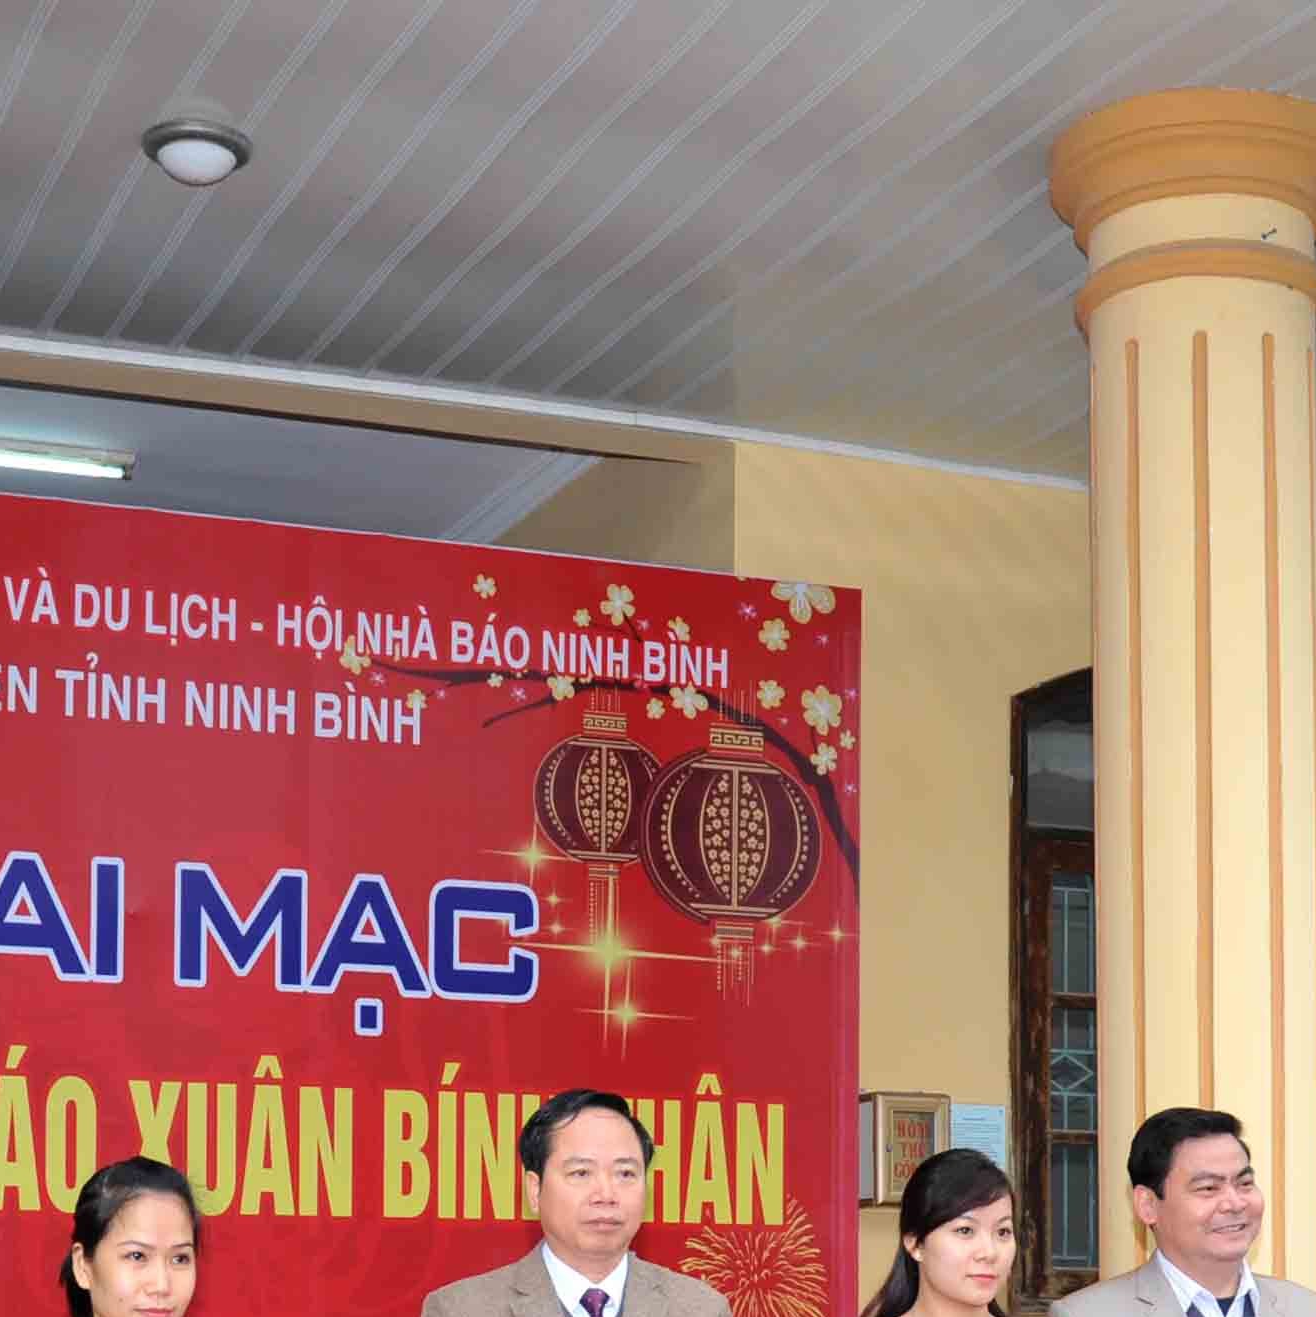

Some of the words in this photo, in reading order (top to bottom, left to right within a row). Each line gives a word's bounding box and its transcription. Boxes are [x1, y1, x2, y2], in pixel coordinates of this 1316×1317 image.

[3, 567, 60, 625] VÀ
[73, 583, 130, 632] DU
[144, 590, 237, 647] LỊCH
[250, 621, 264, 632] -
[277, 594, 343, 660] HỘI
[356, 605, 438, 661] NHÀ
[450, 612, 531, 670] BÁO
[542, 631, 630, 680] NINH
[643, 631, 730, 689] BÌNH
[55, 652, 167, 725] TỈNH
[185, 680, 296, 735] NINH
[314, 680, 421, 746] BÌNH
[174, 860, 539, 1037] MẠC
[129, 1054, 354, 1218] XUÂN
[630, 1073, 785, 1226] HÂN
